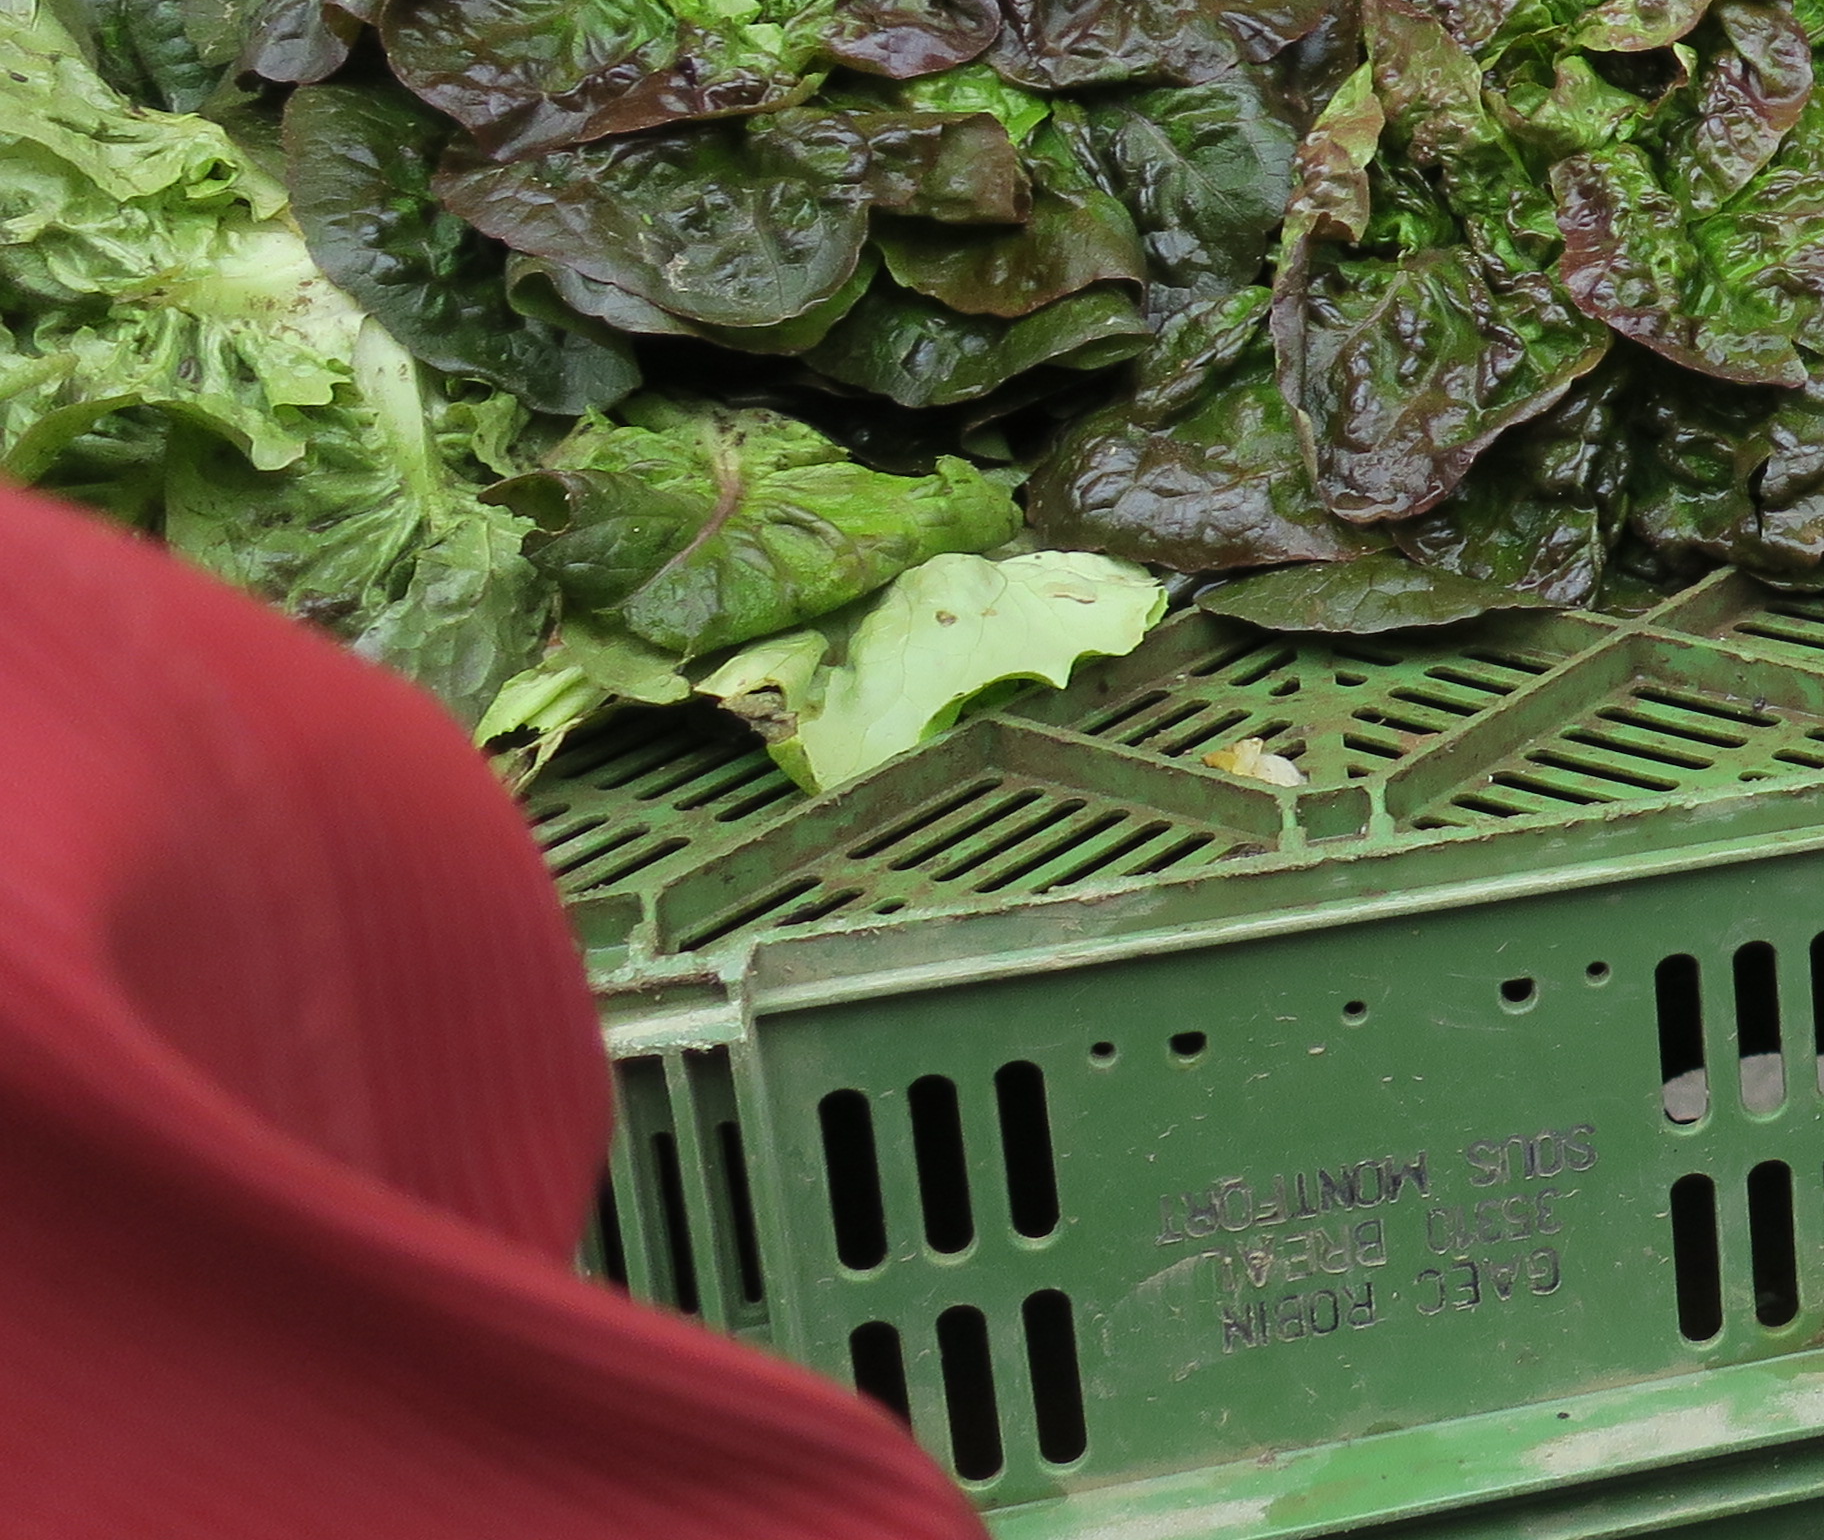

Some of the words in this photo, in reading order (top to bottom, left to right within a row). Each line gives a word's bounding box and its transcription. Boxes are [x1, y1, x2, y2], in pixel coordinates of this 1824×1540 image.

[1465, 1123, 1600, 1188] SOUS
[1154, 1149, 1432, 1247] MONTFORT
[1426, 1187, 1566, 1256] 35310
[1200, 1217, 1389, 1292] BREAL
[1413, 1246, 1562, 1317] GAEC
[1219, 1280, 1378, 1355] ROBIN
